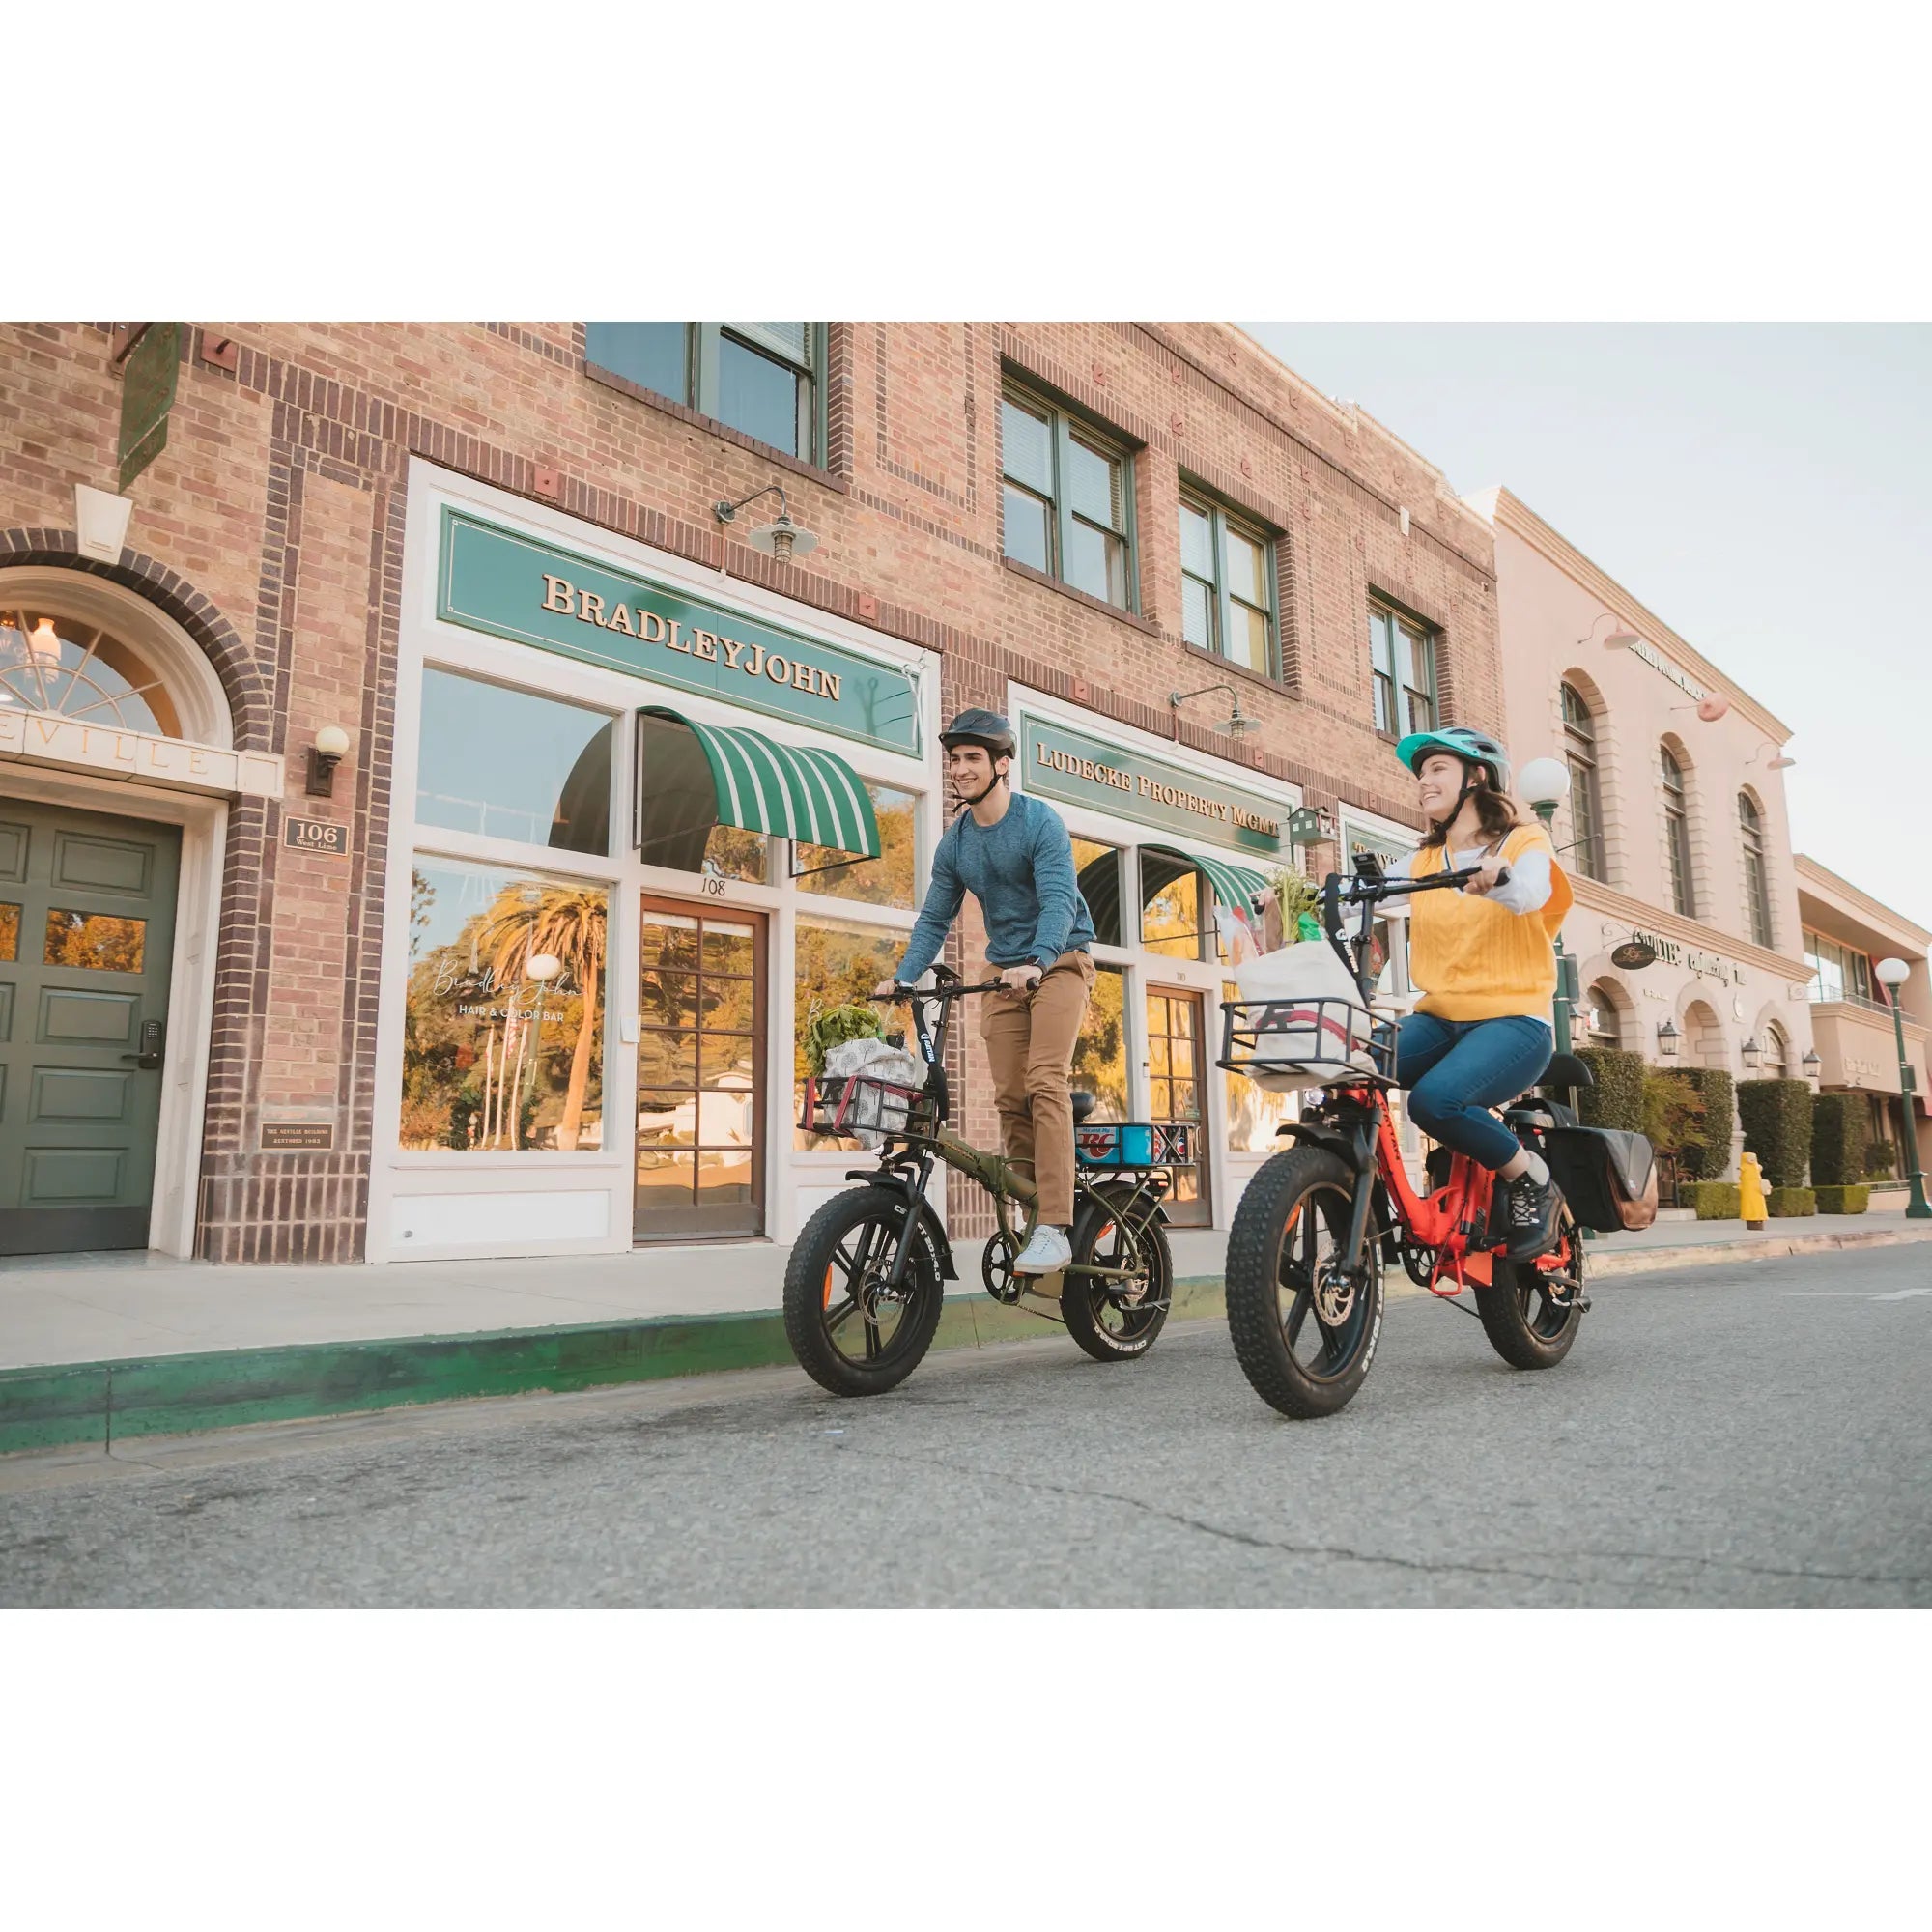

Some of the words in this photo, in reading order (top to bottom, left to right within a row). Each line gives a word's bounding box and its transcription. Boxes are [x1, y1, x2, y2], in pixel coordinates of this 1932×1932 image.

[1037, 741, 1132, 792] LUDECKE
[1136, 774, 1228, 822] PROPERTY
[1230, 804, 1280, 838] MGMT
[296, 822, 338, 844] 106
[296, 838, 315, 847] West
[318, 842, 337, 851] Lime
[701, 877, 725, 896] 108
[459, 1004, 487, 1016] HAIR
[490, 1007, 497, 1017] &
[500, 1008, 540, 1021] COLOR
[543, 1011, 564, 1022] BAR
[923, 1038, 936, 1064] RATTAN
[1077, 1133, 1116, 1158] RC
[894, 1204, 908, 1215] CS
